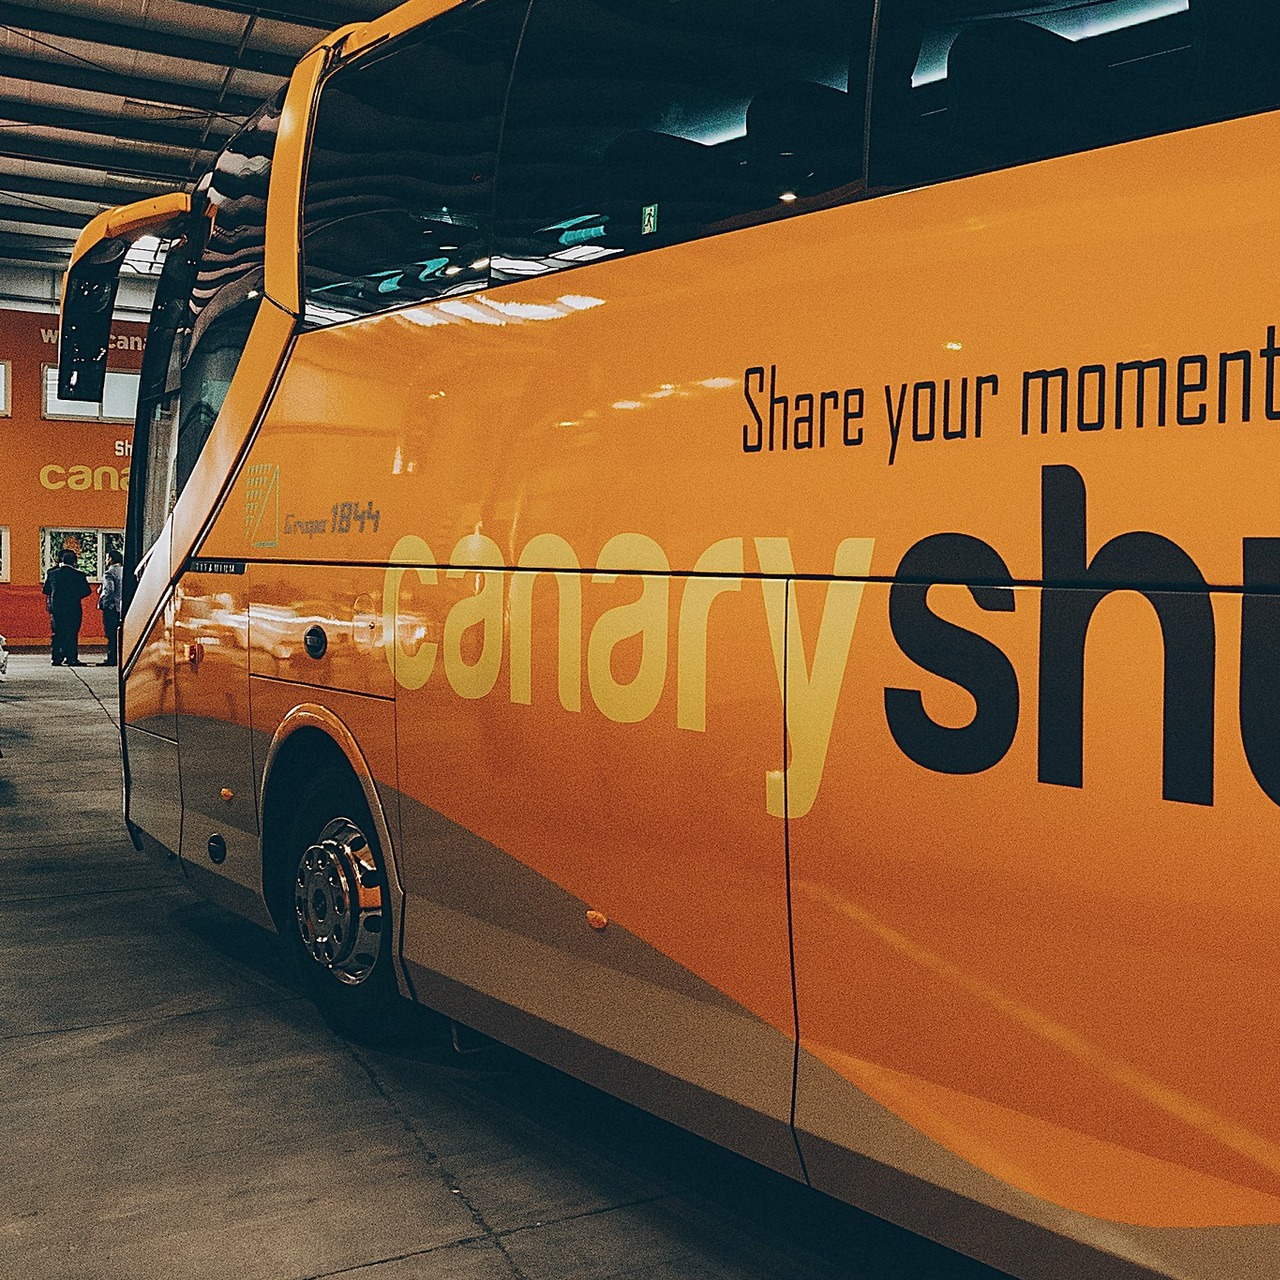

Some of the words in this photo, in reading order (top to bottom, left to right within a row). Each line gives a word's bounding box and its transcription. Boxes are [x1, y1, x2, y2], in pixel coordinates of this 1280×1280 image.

[742, 365, 864, 454] Share
[885, 374, 998, 466] your
[331, 501, 380, 533] 1844
